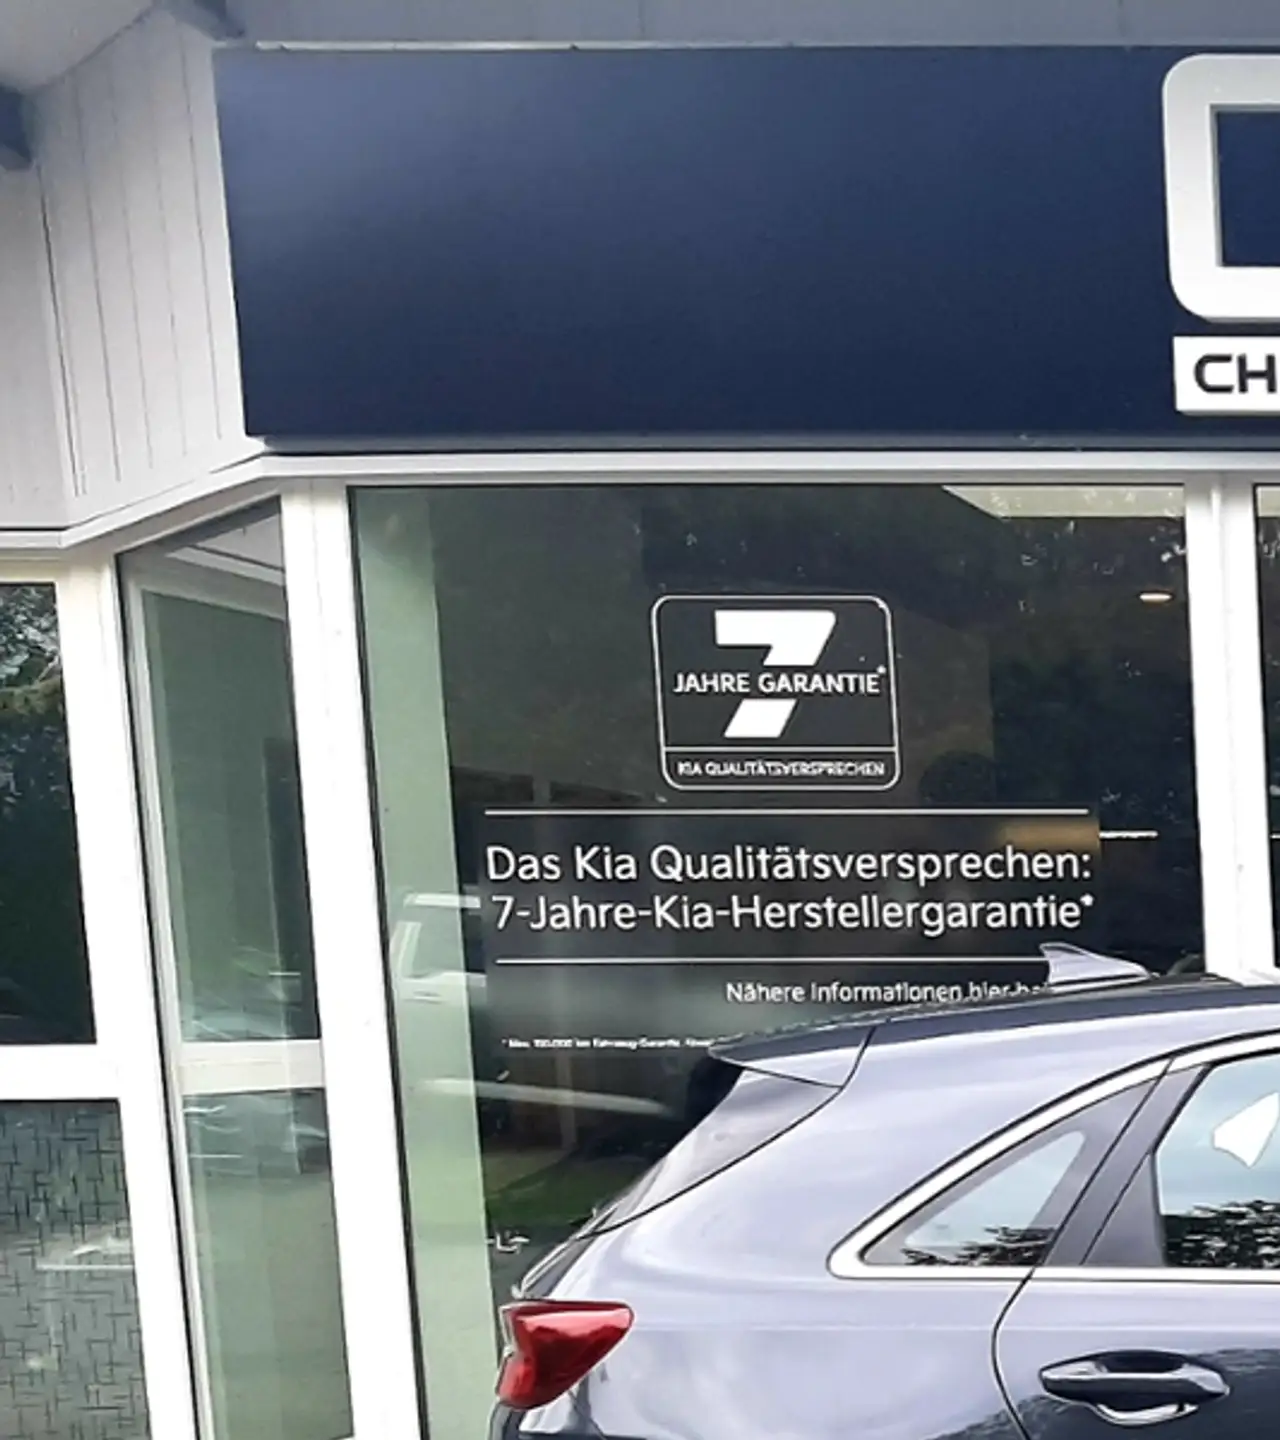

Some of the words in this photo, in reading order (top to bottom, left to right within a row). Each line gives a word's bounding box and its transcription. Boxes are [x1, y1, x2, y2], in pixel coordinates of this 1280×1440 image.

[672, 672, 750, 693] JAHRE
[677, 761, 702, 776] KIA
[705, 759, 886, 777] QUALITÄTSVERSPRECHEN
[486, 845, 561, 880] Das
[574, 845, 637, 880] Kia
[650, 844, 1092, 887] Qualitätsversprechen:
[725, 981, 805, 1002] Nähere
[811, 981, 963, 1003] Informationen
